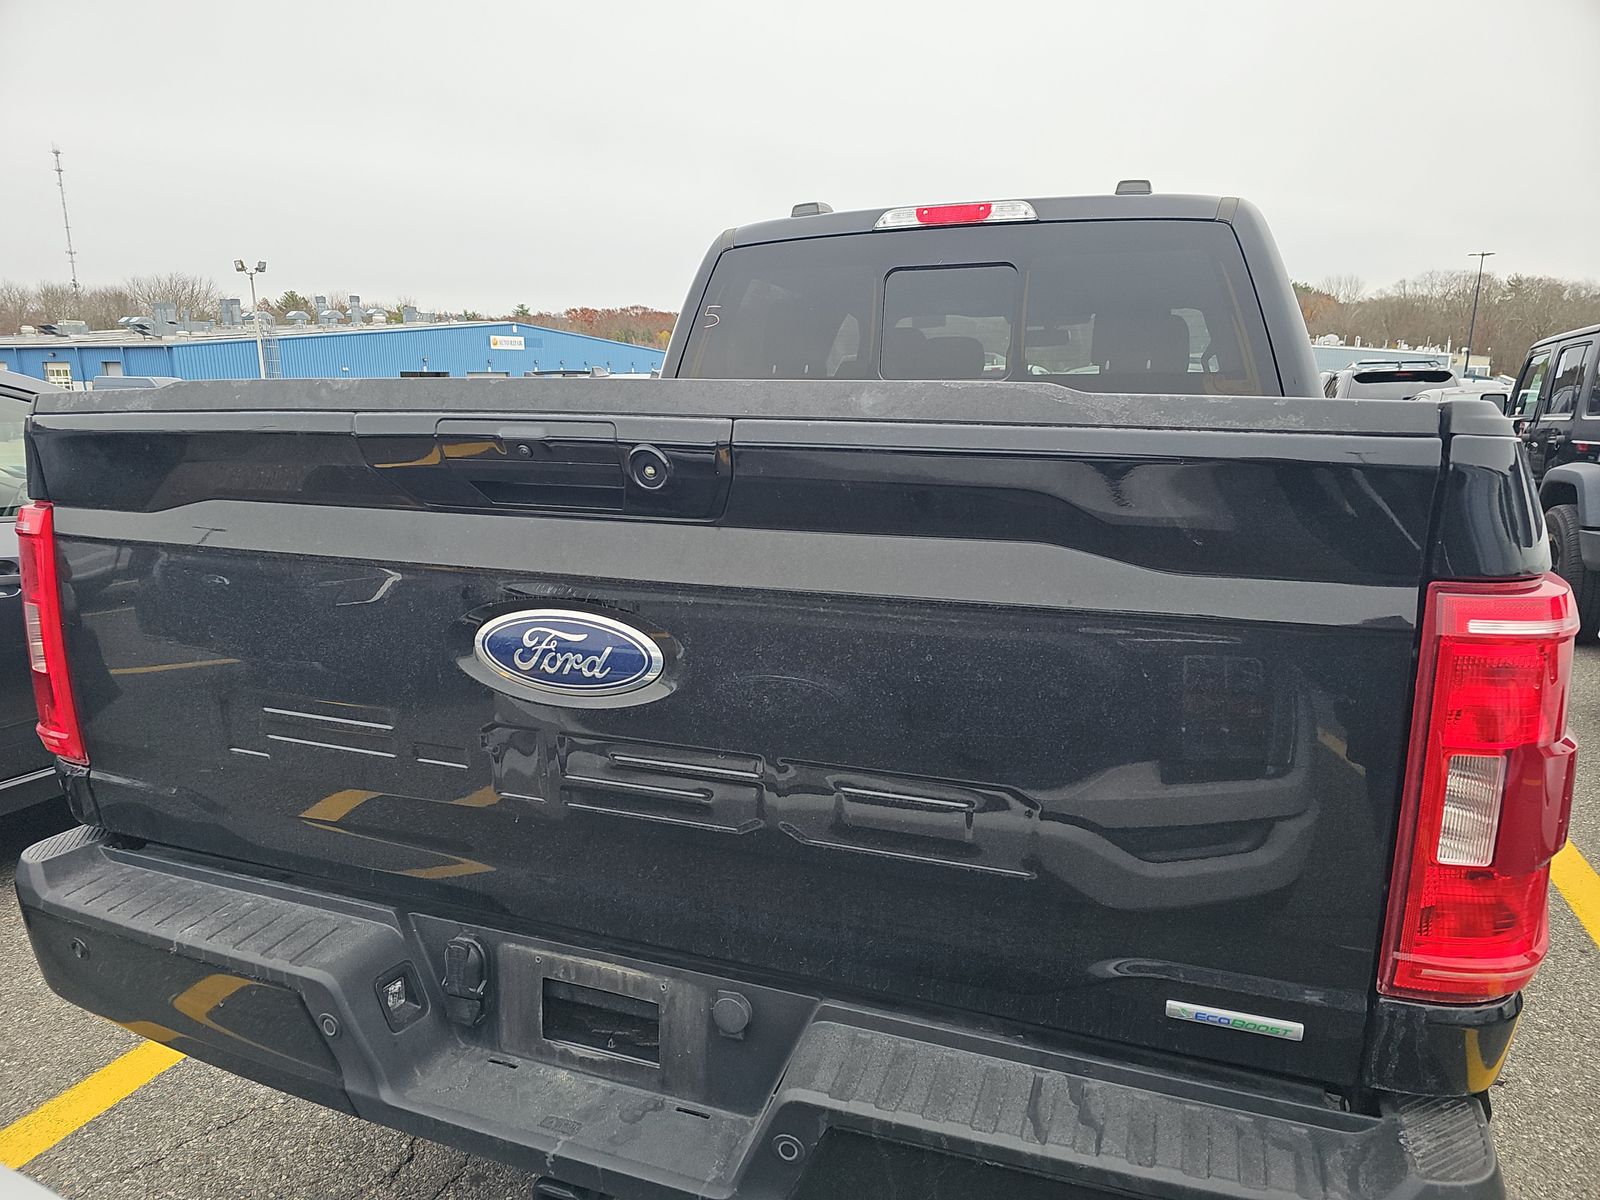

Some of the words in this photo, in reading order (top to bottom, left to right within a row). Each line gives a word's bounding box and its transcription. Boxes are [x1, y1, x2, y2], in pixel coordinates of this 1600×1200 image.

[704, 305, 722, 328] 5
[513, 627, 613, 679] Ford
[226, 688, 1041, 880] F-150
